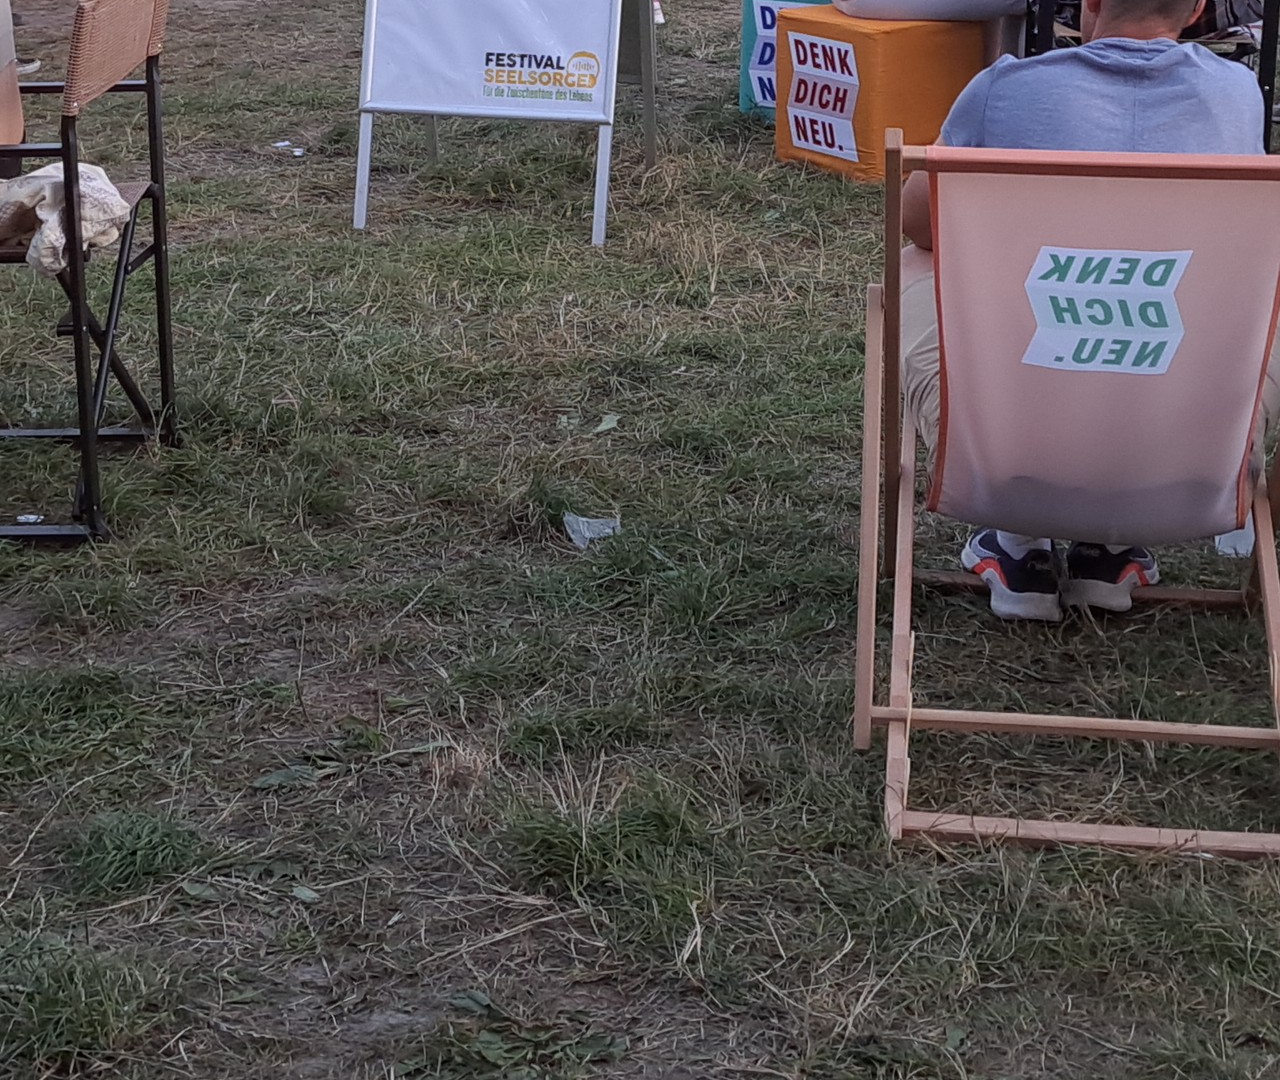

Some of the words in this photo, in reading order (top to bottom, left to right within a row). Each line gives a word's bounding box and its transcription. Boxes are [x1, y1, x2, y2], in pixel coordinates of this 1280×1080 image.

[485, 52, 565, 70] FESTIVAL
[794, 39, 854, 77] DENK
[484, 68, 592, 88] SEELSORGE
[794, 78, 848, 114] DICH
[793, 114, 844, 151] NEU.
